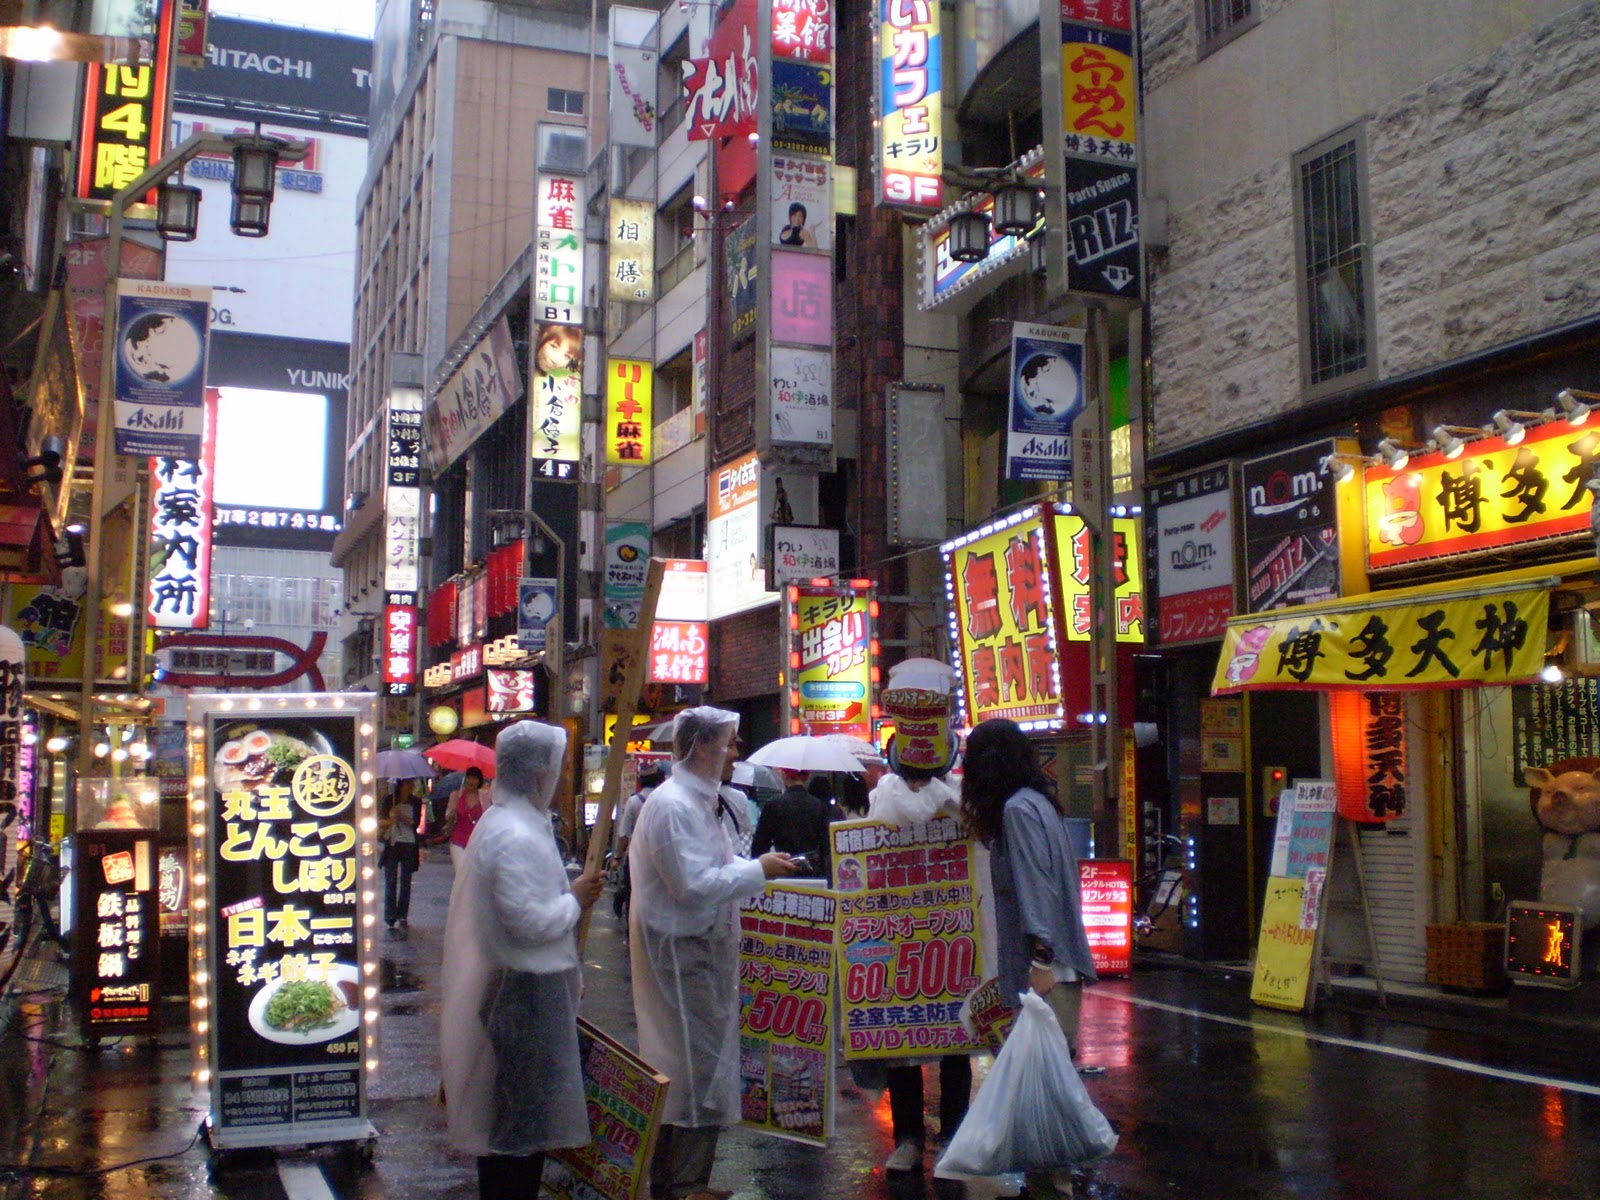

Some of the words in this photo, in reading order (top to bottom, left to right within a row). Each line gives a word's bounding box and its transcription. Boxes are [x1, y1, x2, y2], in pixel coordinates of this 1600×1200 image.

[206, 48, 312, 79] HITACHI
[1070, 46, 1126, 138] らーめん
[886, 136, 939, 158] キラリ
[1065, 133, 1134, 159] 博多天神
[885, 174, 940, 202] 3F
[1068, 184, 1098, 206] Party
[1098, 172, 1131, 196] Space
[547, 178, 575, 231] 麻雀
[1069, 199, 1138, 265] RIZ
[549, 233, 578, 305] メトロ
[635, 290, 649, 299] 4F
[544, 307, 572, 320] B1
[773, 378, 798, 389] わい
[126, 407, 184, 430] Asahi
[614, 363, 643, 460] リーチ麻雀
[815, 430, 829, 440] B1
[1022, 436, 1069, 456] Asahi
[393, 472, 416, 482] 3F
[539, 459, 571, 478] 4F
[777, 541, 803, 552] わい
[1322, 529, 1334, 539] B1
[673, 562, 687, 570] 2F
[389, 593, 412, 604] 焼肉
[803, 594, 855, 624] キラリ
[388, 611, 411, 678] 安楽亭
[802, 611, 863, 666] 出会い
[1276, 600, 1529, 683] 博多天神
[826, 645, 866, 680] カフェ
[390, 683, 407, 694] 2F
[301, 766, 340, 806] 極
[221, 787, 293, 822] 丸玉
[220, 822, 356, 862] とんこつ
[272, 857, 356, 894] しぼり
[1081, 866, 1098, 879] 2F
[841, 886, 972, 914] さくら通りのど真ん中!!
[97, 892, 123, 978] 鉄板鍋
[227, 904, 353, 949] 日本一
[841, 909, 975, 942] グランドオープン!!
[237, 952, 340, 986] ネギ餃子
[895, 935, 981, 999] 500円
[1093, 960, 1128, 969] 200-2233
[846, 961, 894, 1003] 60分
[749, 988, 827, 1046] 500円
